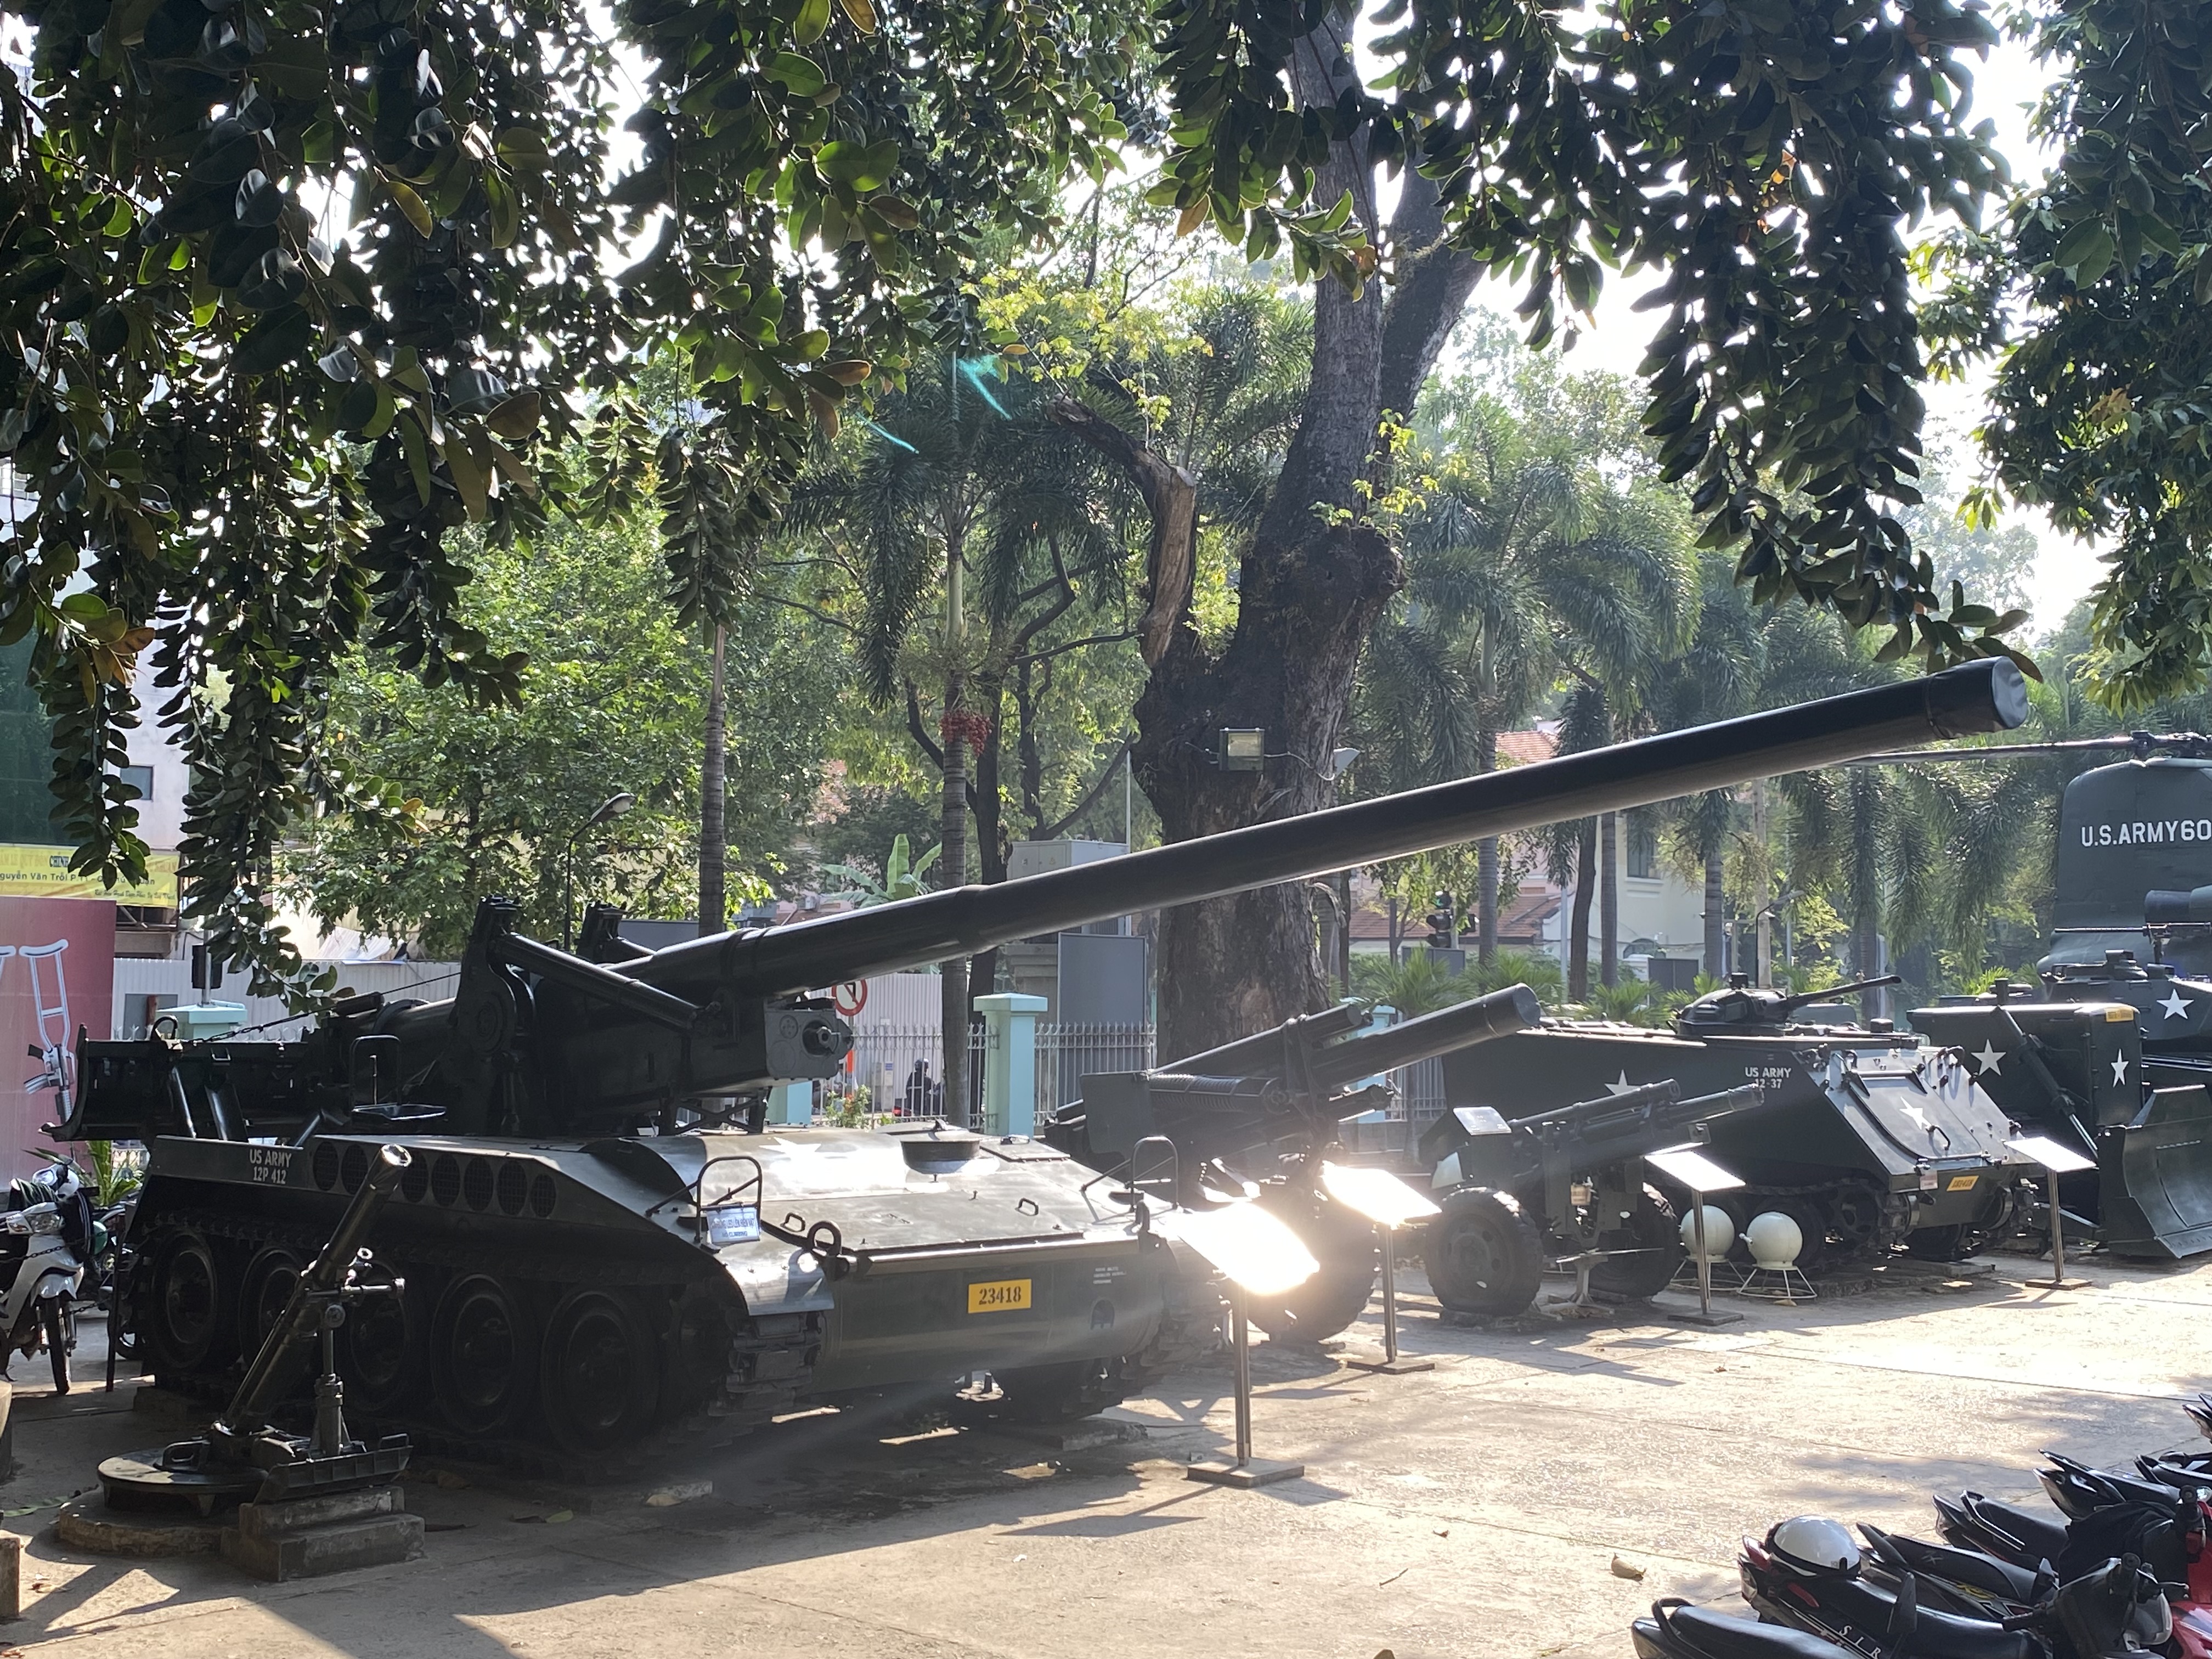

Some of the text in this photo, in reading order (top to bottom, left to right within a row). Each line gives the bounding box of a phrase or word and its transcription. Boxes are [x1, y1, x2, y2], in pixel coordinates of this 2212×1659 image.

[1745, 1067, 1792, 1078] US ARMY
[250, 1148, 292, 1168] US ARMY
[253, 1166, 286, 1184] 12P 412
[978, 1286, 1022, 1305] 23418
